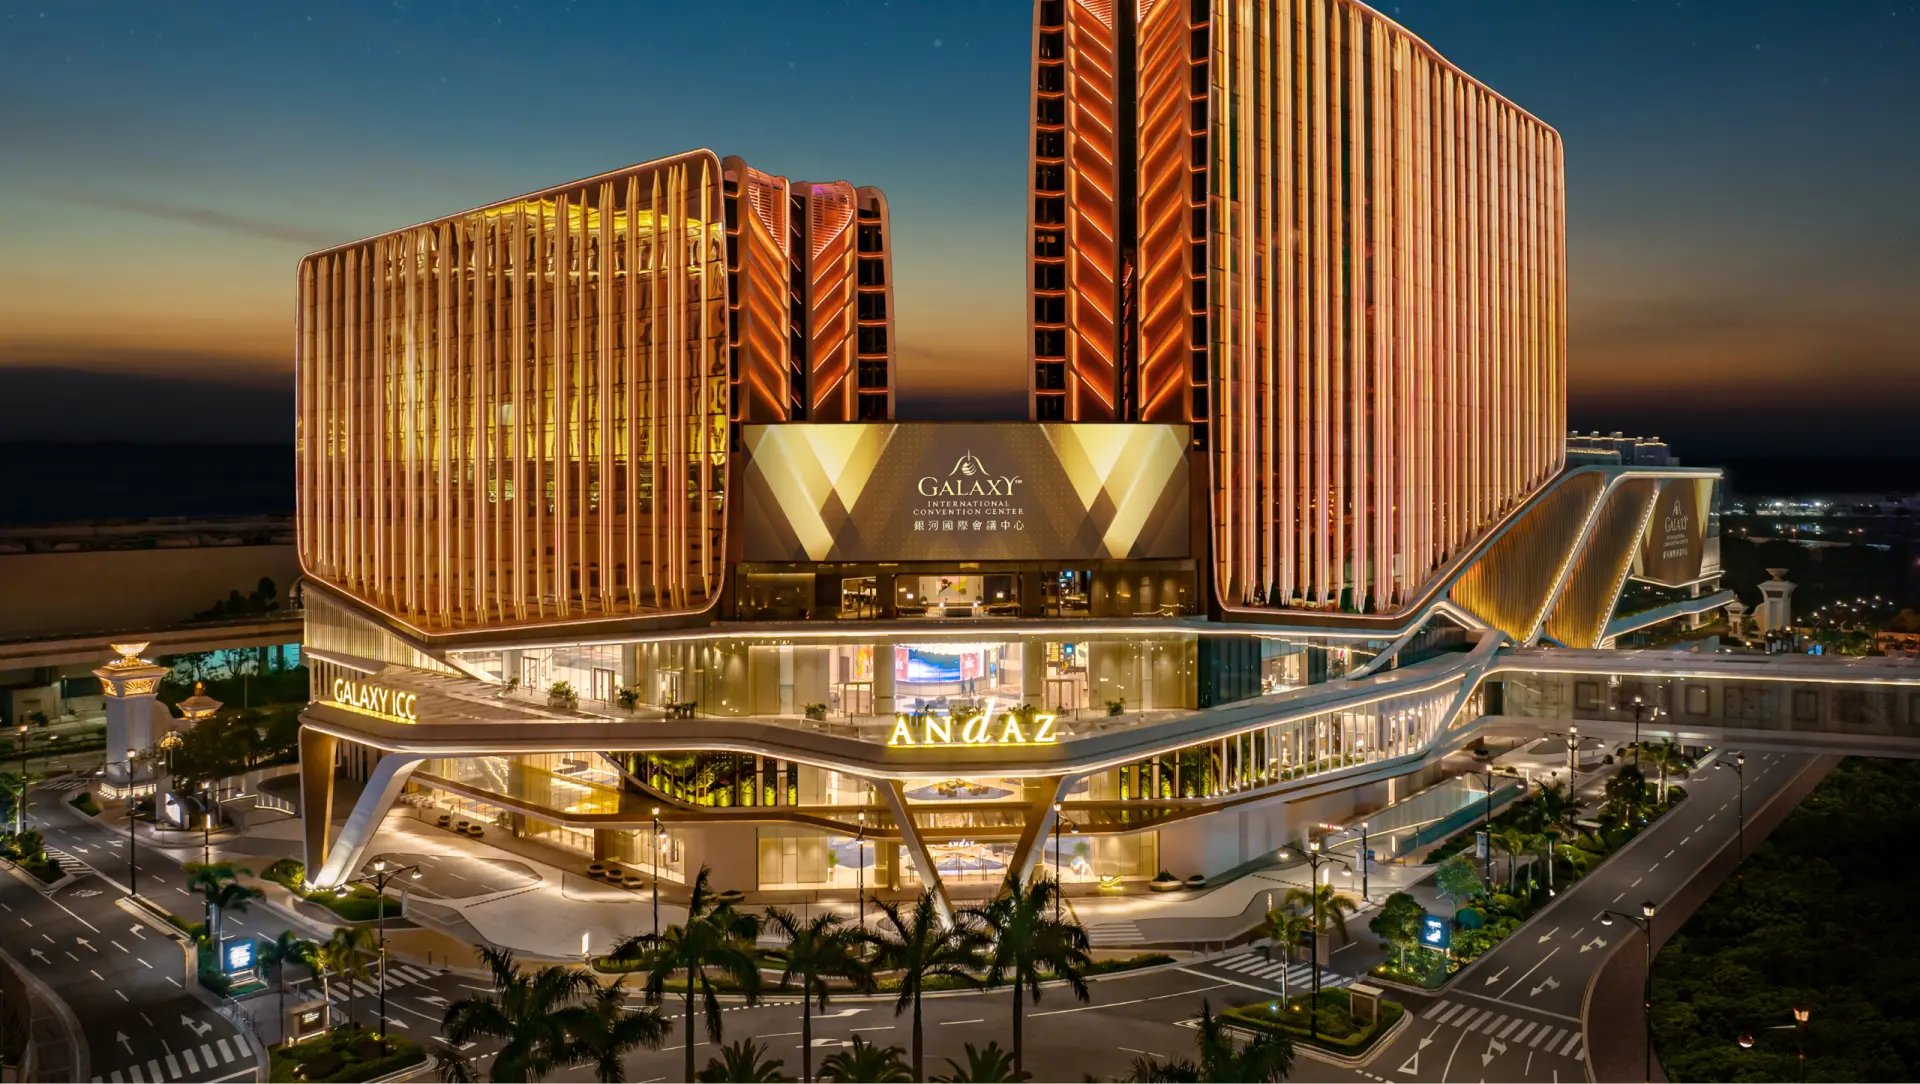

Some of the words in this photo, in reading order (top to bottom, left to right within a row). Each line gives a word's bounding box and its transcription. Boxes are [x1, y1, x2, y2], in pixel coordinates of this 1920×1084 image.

[917, 476, 1020, 497] GALAXY
[913, 508, 981, 516] CONVENTION
[913, 520, 1025, 531] 銀河國際會議中心
[334, 678, 388, 713] GALAXY
[392, 690, 416, 720] ICC
